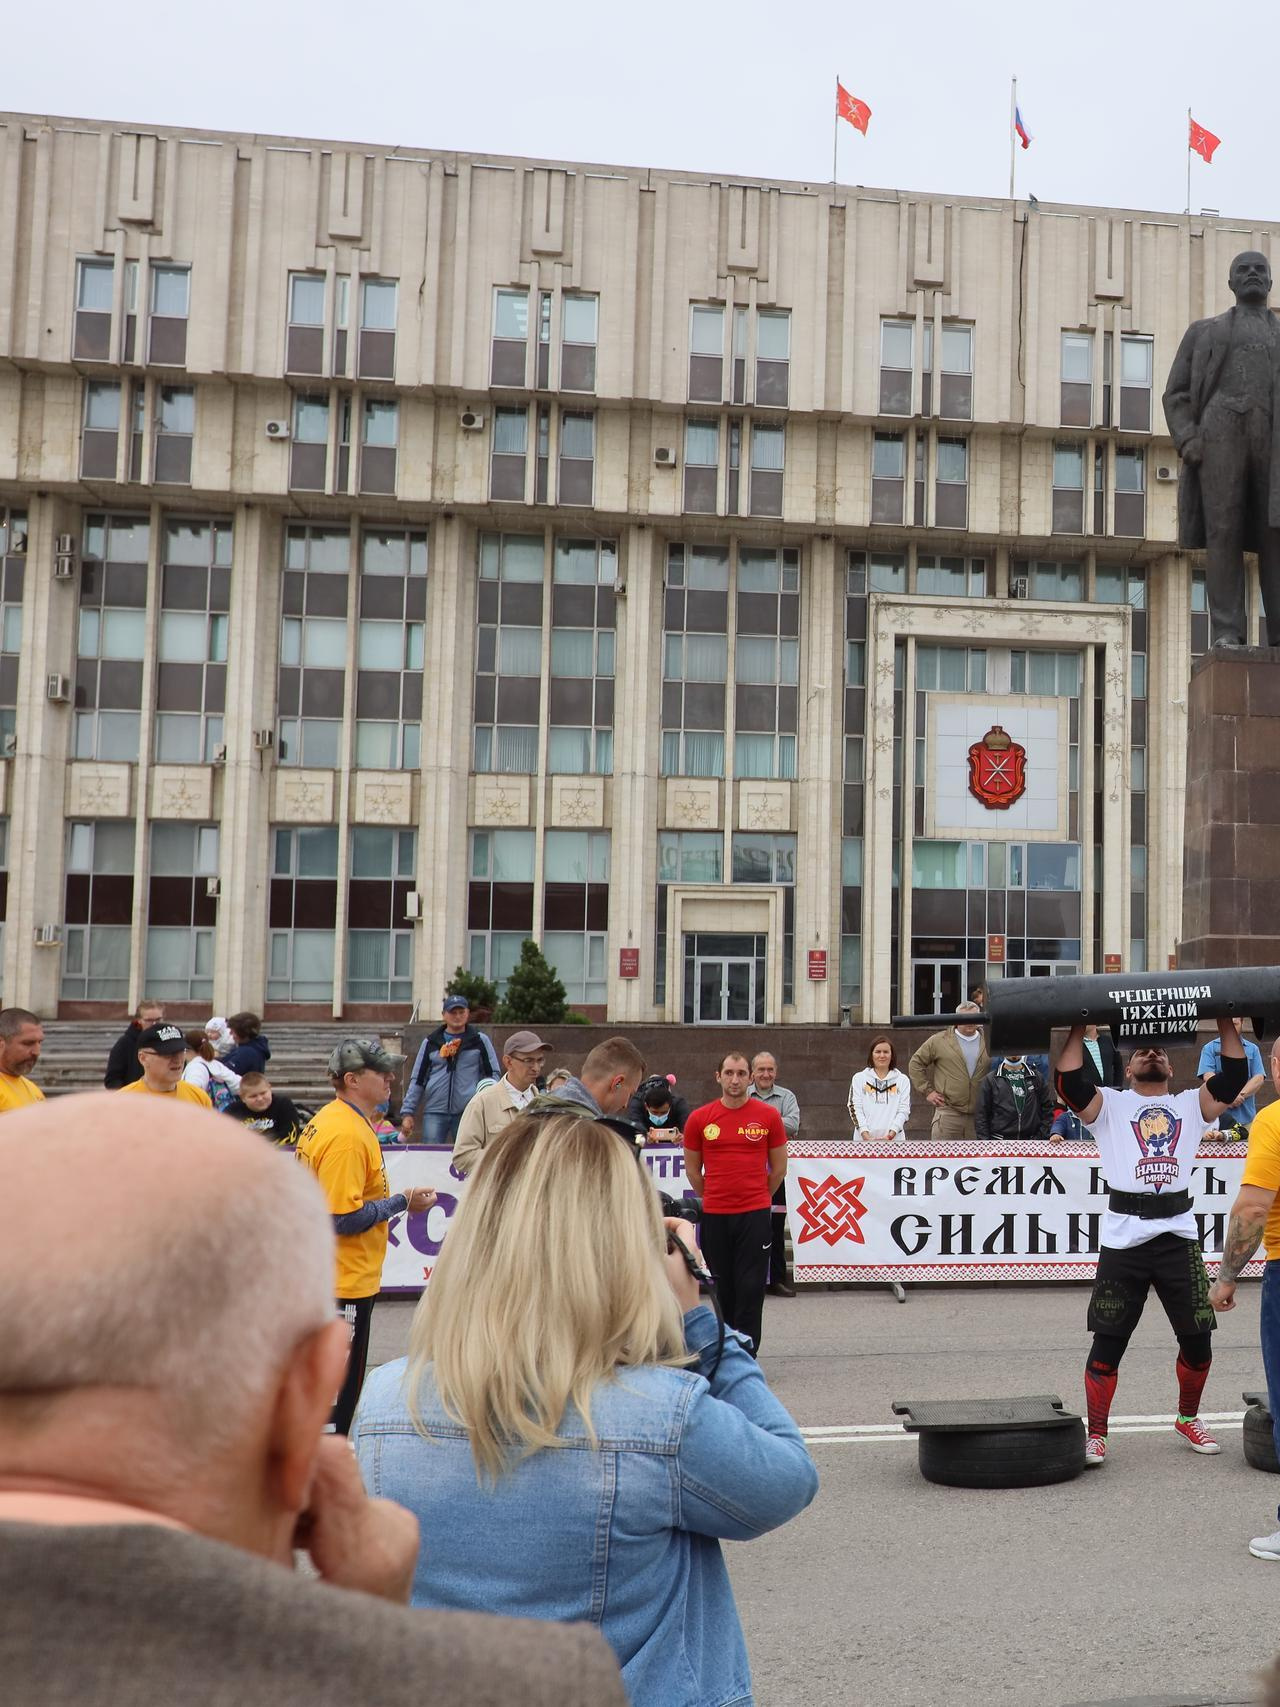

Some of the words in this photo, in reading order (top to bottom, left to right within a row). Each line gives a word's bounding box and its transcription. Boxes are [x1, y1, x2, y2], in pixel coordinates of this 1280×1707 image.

[1108, 985, 1212, 1003] ФЕДЕРАЦИЯ
[1121, 1001, 1198, 1020] ТЯЖЁЛОЙ
[1120, 1019, 1199, 1036] АТЛЕТИКИ
[1136, 1163, 1179, 1178] НАЦИЯ
[1145, 1174, 1172, 1184] МИРА
